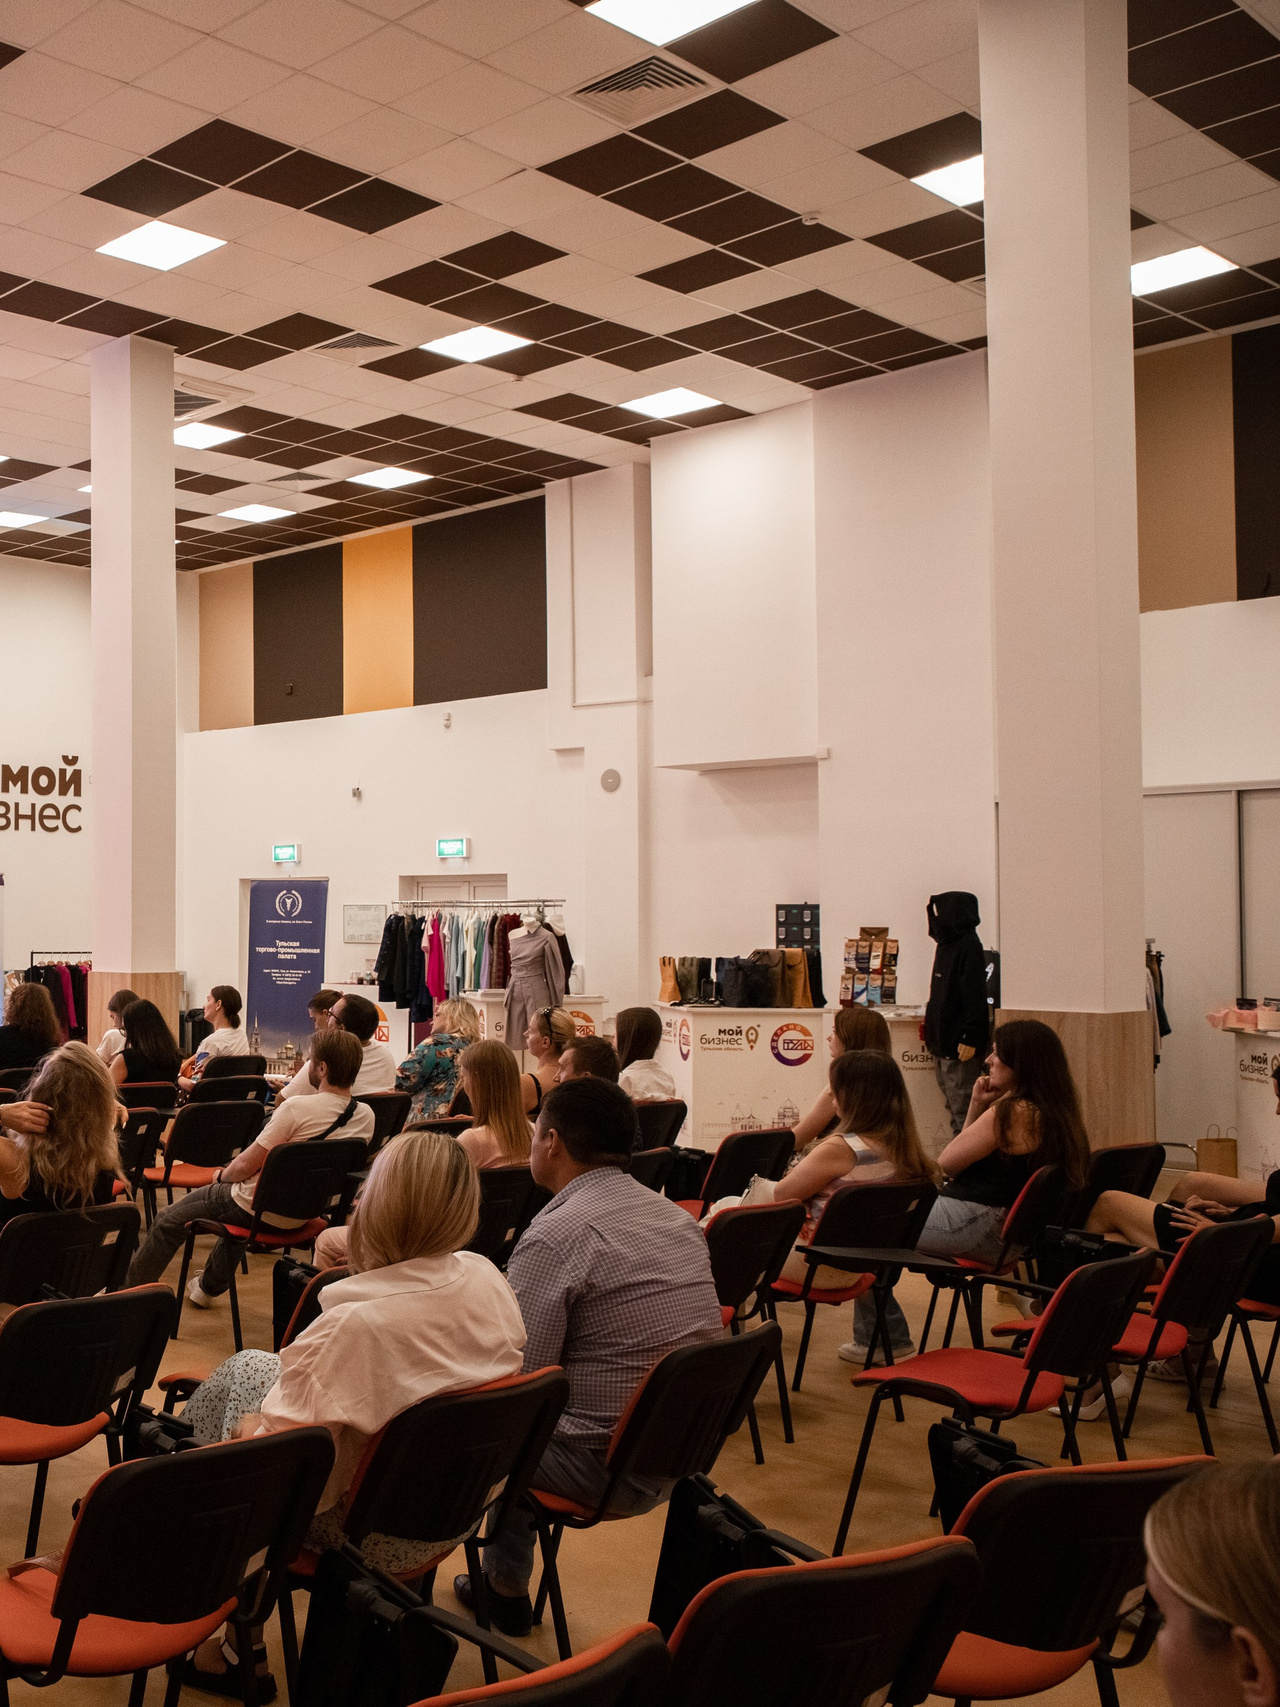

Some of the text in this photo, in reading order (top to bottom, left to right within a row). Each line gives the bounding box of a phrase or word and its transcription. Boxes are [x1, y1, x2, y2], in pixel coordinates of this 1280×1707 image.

[1, 754, 82, 798] мой
[276, 940, 300, 948] Тульская
[718, 1026, 743, 1036] мой
[700, 1034, 742, 1046] бизнес
[772, 1024, 802, 1054] СДЕЛАНО
[902, 1050, 934, 1062] бизн
[1250, 1052, 1268, 1066] мой
[1240, 1060, 1268, 1076] бизнес
